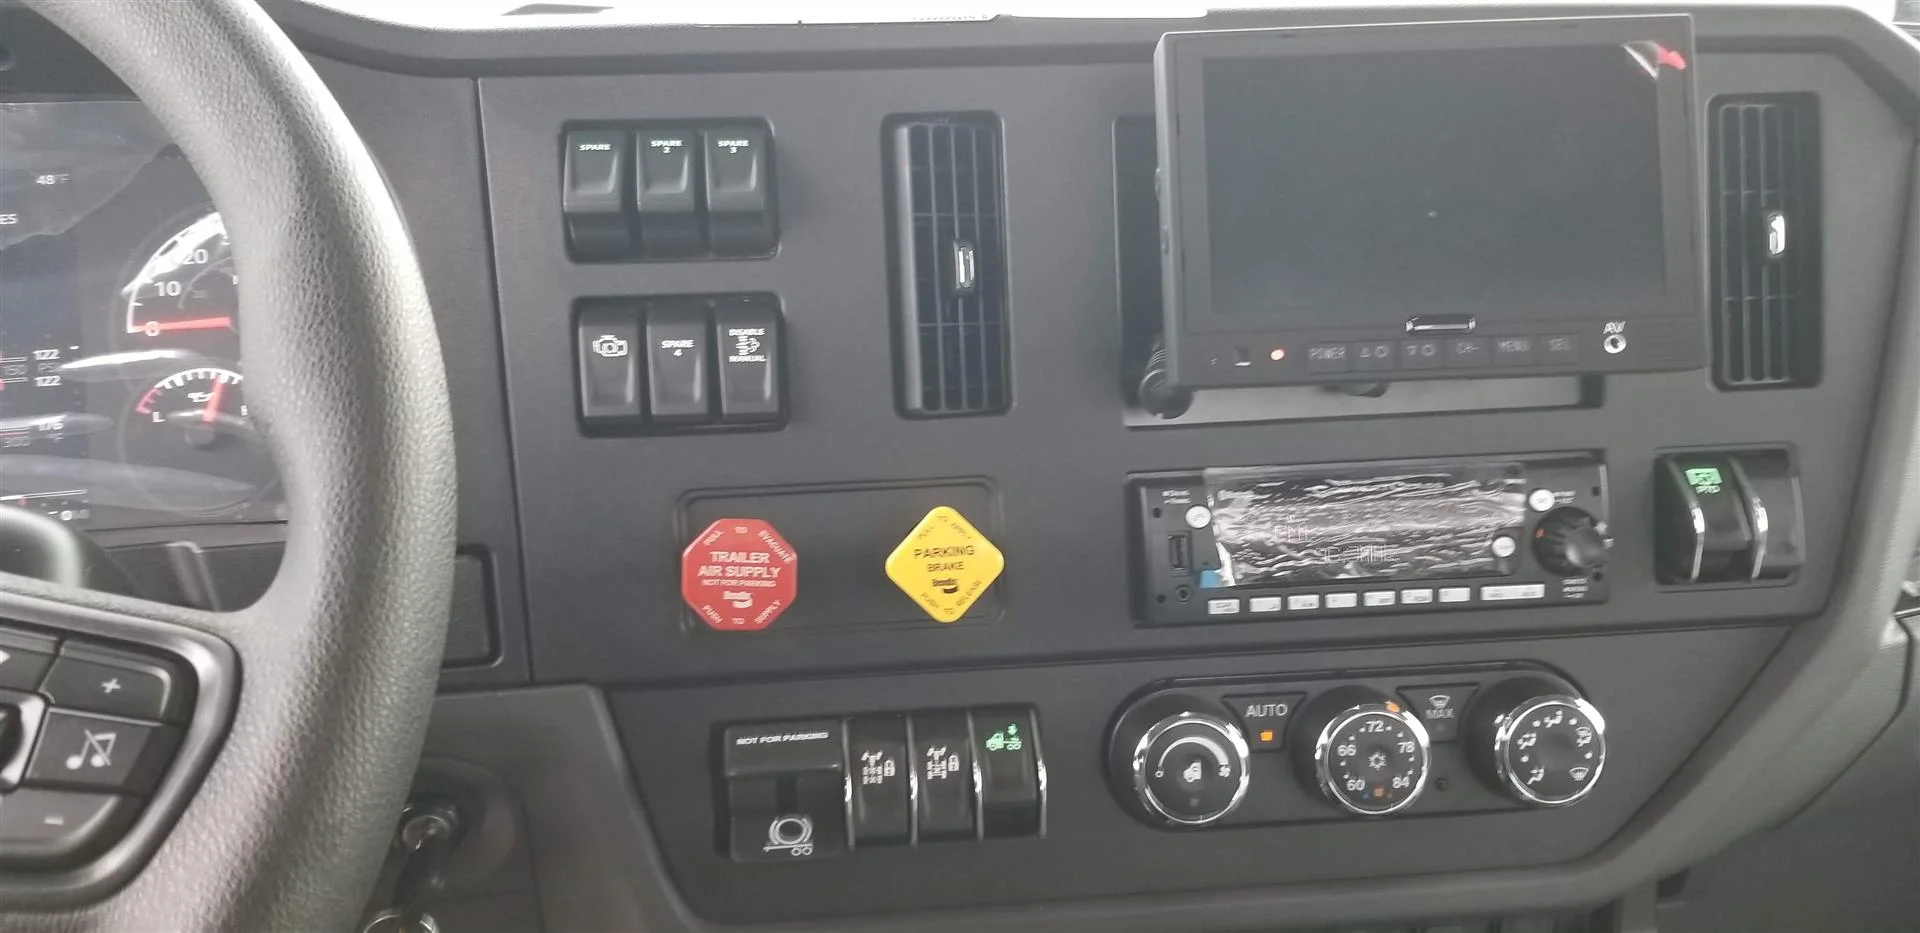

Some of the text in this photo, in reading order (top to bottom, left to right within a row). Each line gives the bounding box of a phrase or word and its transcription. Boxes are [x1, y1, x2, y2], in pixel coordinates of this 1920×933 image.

[579, 143, 611, 151] SPARE
[182, 248, 209, 264] 20
[154, 280, 182, 297] 10
[1603, 320, 1626, 334] AV
[661, 339, 695, 348] SPARE
[33, 348, 61, 361] 122
[34, 375, 62, 387] 122
[152, 411, 166, 423] L
[709, 551, 771, 563] TRAILER
[914, 545, 975, 559] PARKING
[697, 565, 781, 578] AIR SUPPLY
[927, 561, 965, 572] BRAKE
[738, 580, 777, 588] PARKING
[1245, 703, 1288, 717] AUTO
[1425, 708, 1455, 719] MAX
[1365, 720, 1385, 733] 72
[736, 732, 828, 745] NOT FOR PARKING
[1337, 744, 1357, 757] 66
[1397, 741, 1416, 754] 78
[1346, 779, 1366, 791] 60
[1392, 776, 1411, 789] 84
